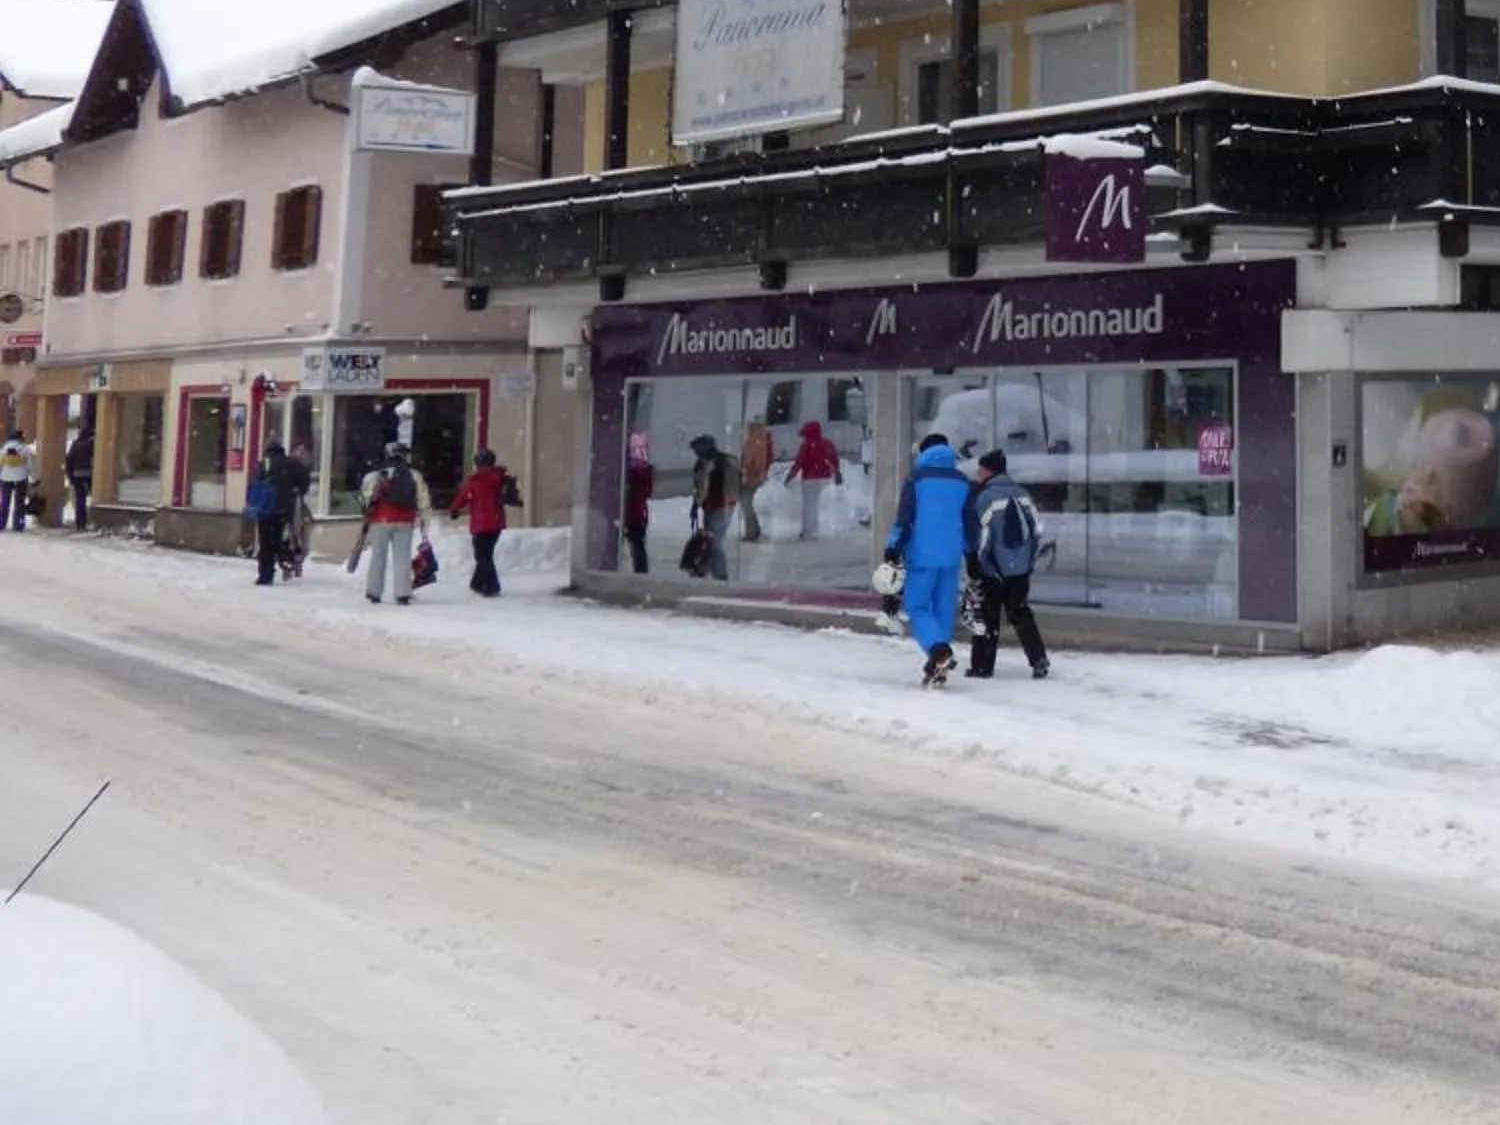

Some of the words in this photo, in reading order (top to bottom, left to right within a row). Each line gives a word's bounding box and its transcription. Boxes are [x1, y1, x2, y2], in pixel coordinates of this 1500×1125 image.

[1075, 174, 1132, 242] M
[656, 311, 797, 365] Marionnaud
[866, 298, 897, 345] M
[972, 292, 1164, 355] Marionnaud
